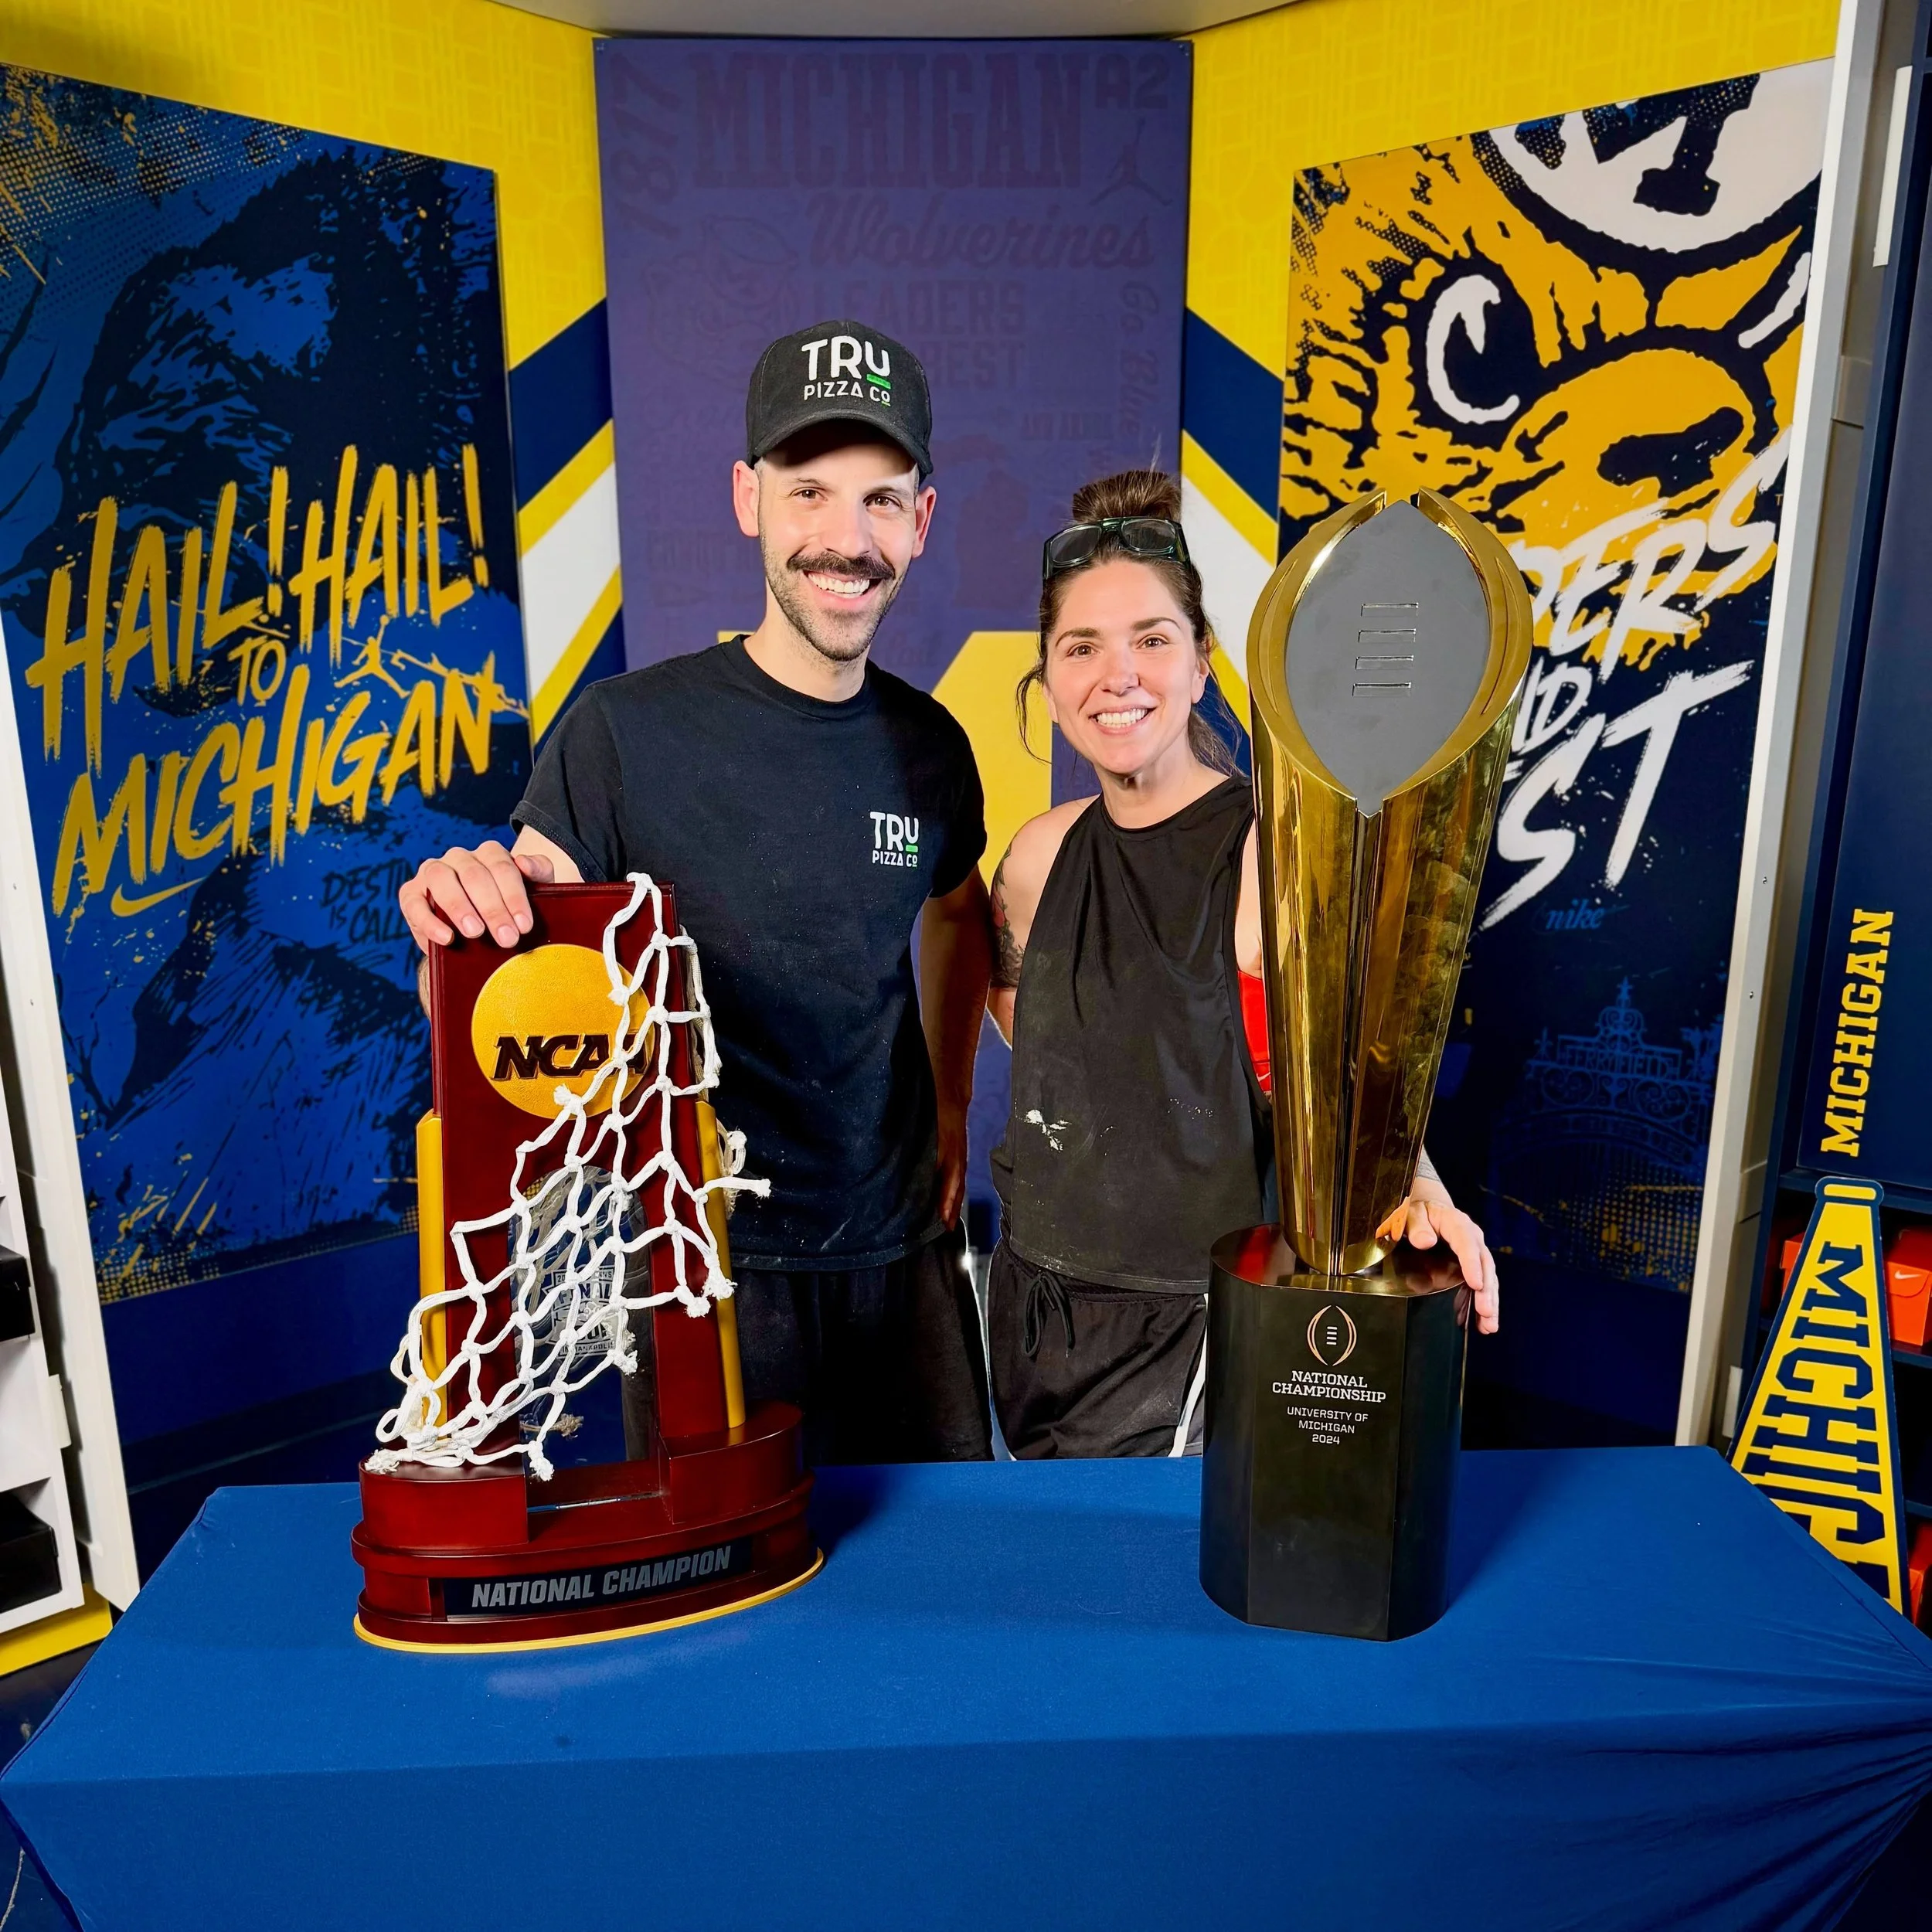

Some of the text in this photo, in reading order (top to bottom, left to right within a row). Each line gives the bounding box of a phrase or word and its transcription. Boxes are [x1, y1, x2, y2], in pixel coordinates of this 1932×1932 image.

[687, 51, 1090, 189] MICHIGAN
[804, 189, 1155, 269] Wolverines
[801, 335, 890, 381] TRU
[804, 381, 863, 400] PIZZA
[1509, 423, 1791, 682] DERS
[25, 443, 489, 778] HAIL! HAIL!
[228, 635, 287, 706] TO
[52, 651, 498, 917] MICHIGAN
[869, 811, 919, 852] TRU
[872, 849, 903, 866] PIZZA
[349, 903, 413, 944] CALL
[1545, 898, 1606, 930] nike
[1821, 908, 1893, 1157] MICHIGAN
[1272, 1382, 1386, 1403] CHAMPIONSHIP
[1291, 1370, 1368, 1388] NATIONAL
[1287, 1406, 1369, 1422] UNIVERSITY OF
[1298, 1420, 1355, 1434] MICHIGAN
[1740, 1241, 1891, 1598] MICHIG
[1311, 1434, 1341, 1444] 2024
[471, 1545, 732, 1607] NATIONAL CHAMPION
